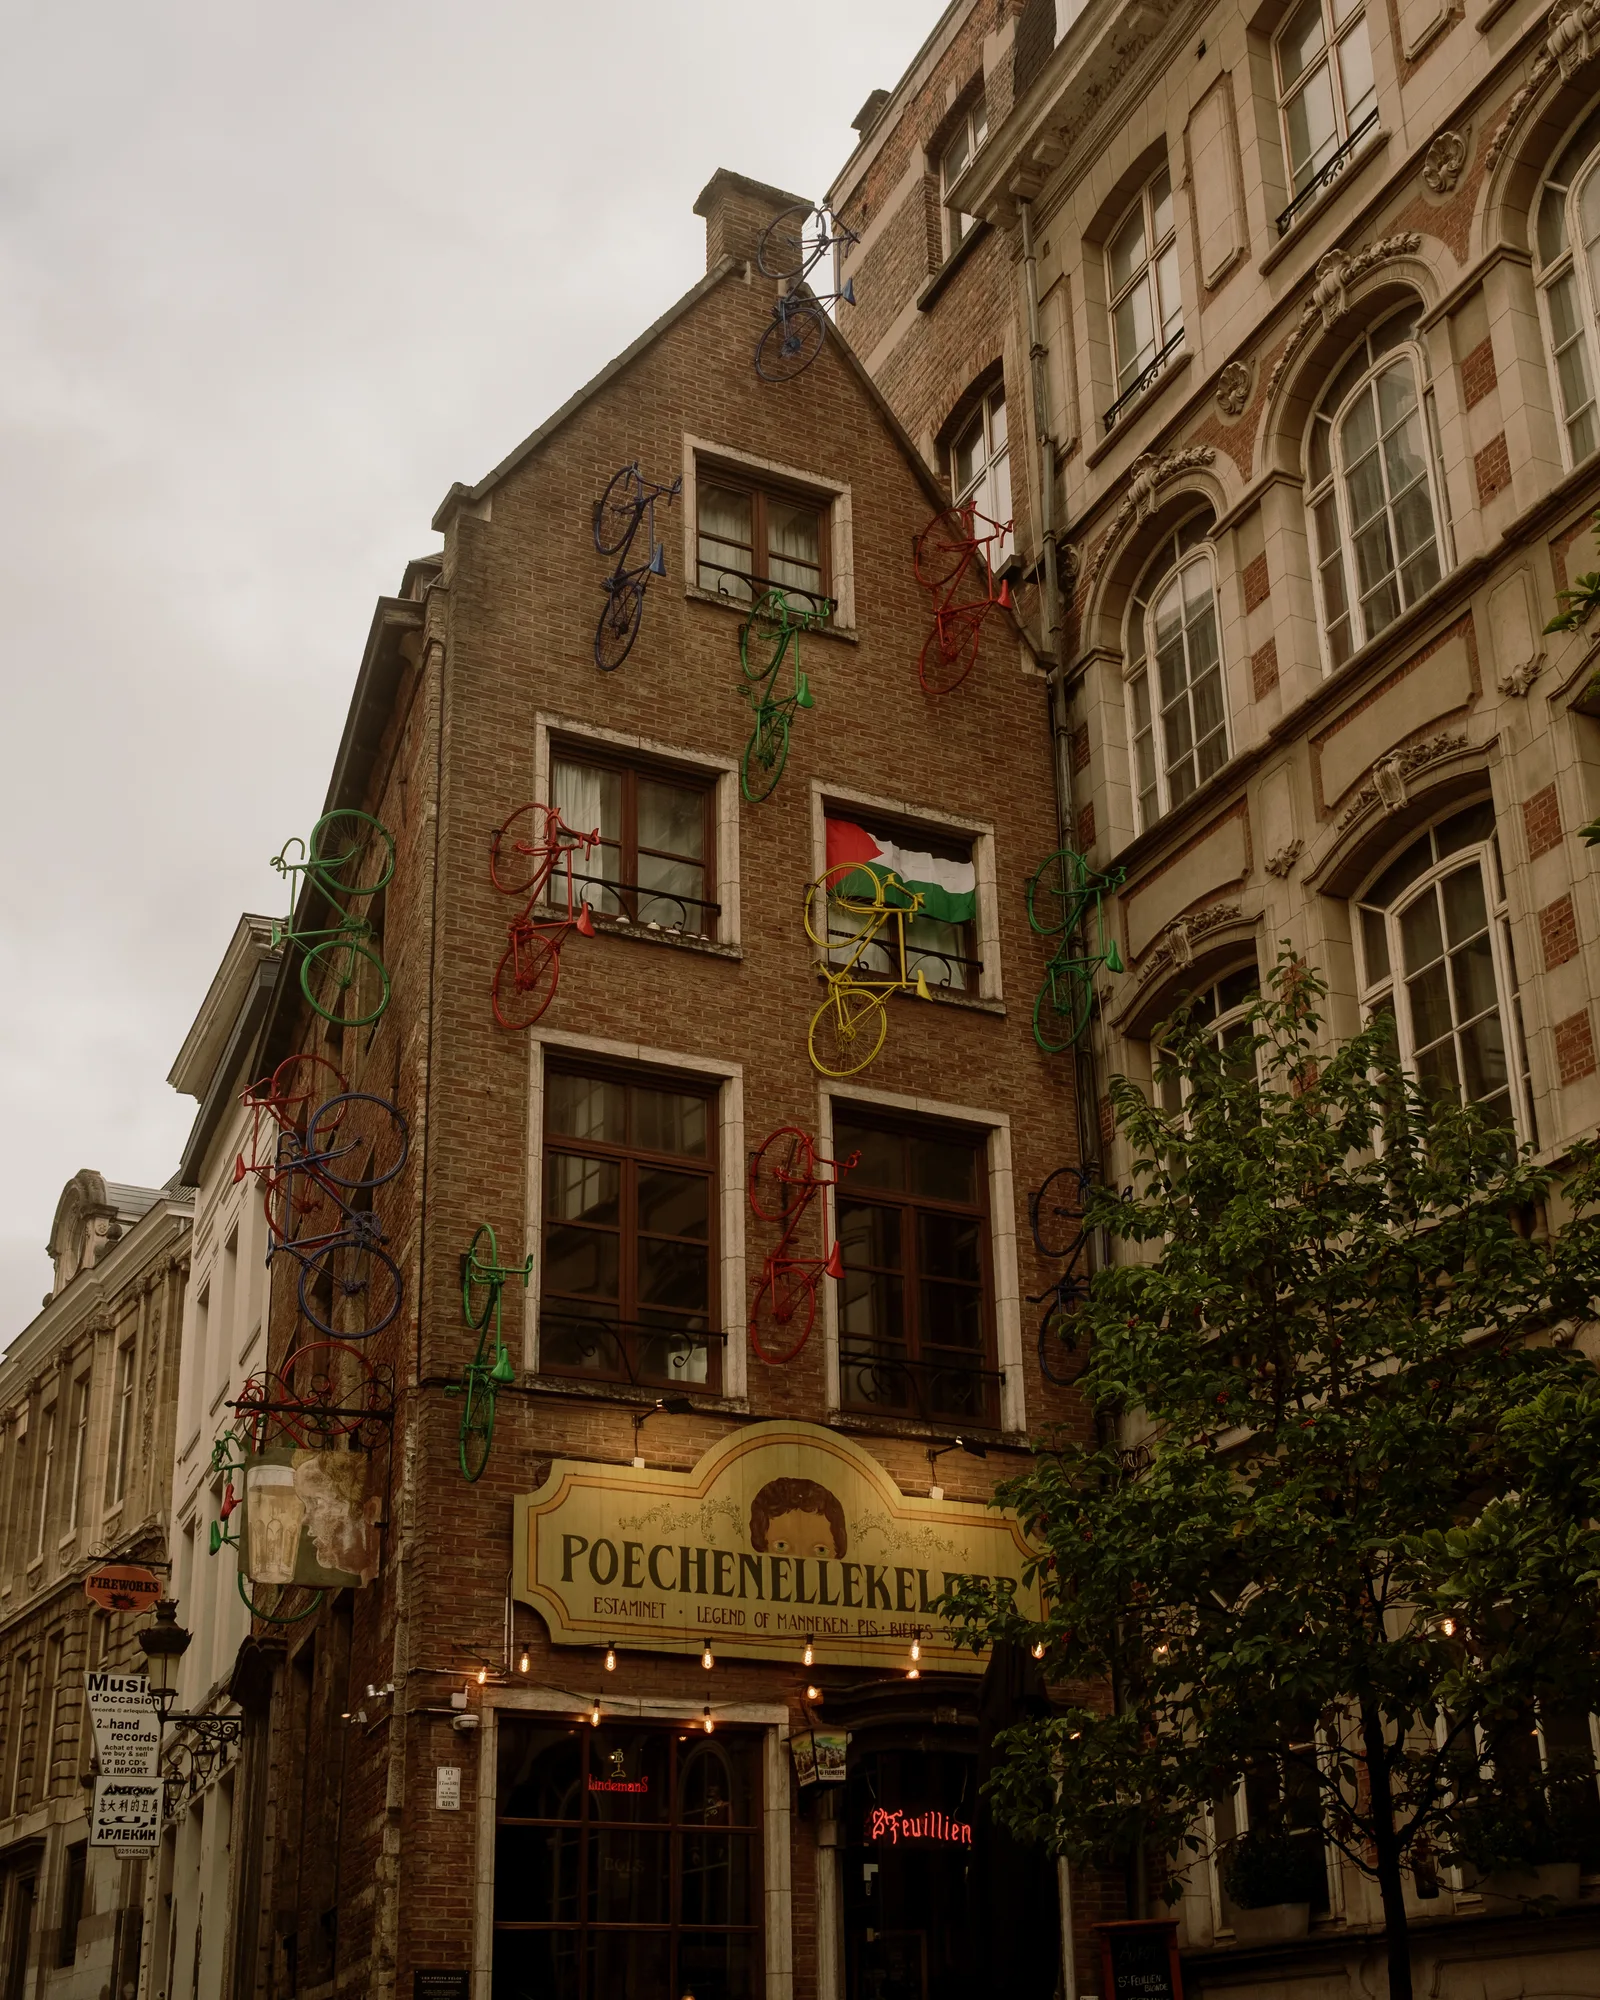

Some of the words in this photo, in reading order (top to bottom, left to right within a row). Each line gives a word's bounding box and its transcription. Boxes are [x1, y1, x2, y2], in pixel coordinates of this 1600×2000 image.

[90, 1577, 159, 1593] FIREWORKS
[593, 1597, 667, 1620] ESTAMINET
[697, 1606, 746, 1627] LEGEND
[754, 1612, 770, 1629] OF
[777, 1613, 848, 1635] MANNEKEN
[857, 1620, 878, 1637] PIS
[92, 1694, 160, 1705] d'occasion
[110, 1719, 140, 1730] hand
[111, 1732, 158, 1743] records
[97, 1828, 156, 1840] АРЛЕКИН
